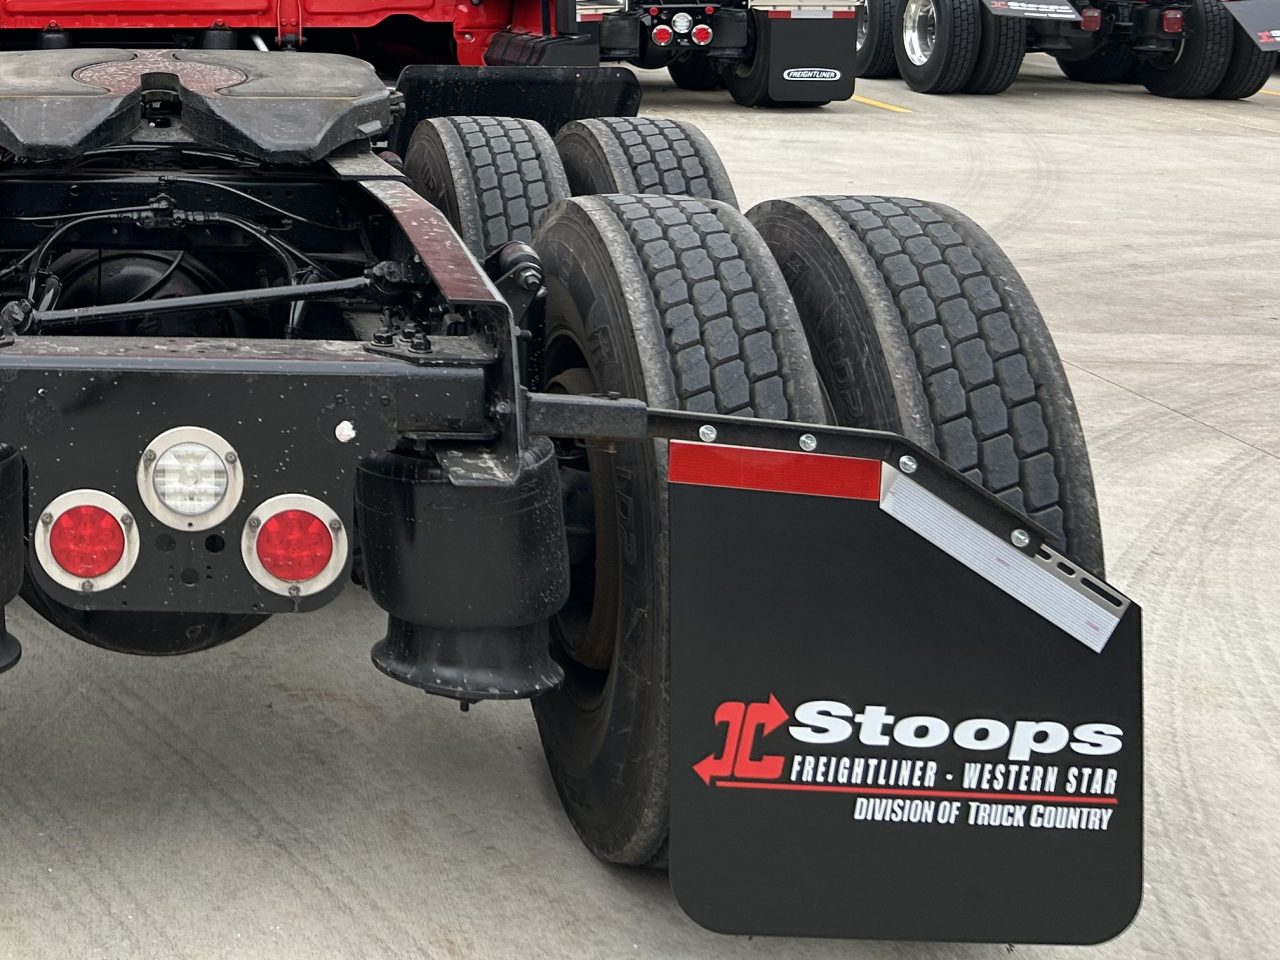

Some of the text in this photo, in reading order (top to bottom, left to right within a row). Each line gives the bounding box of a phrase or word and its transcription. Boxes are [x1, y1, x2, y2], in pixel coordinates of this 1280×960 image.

[788, 700, 1124, 762] Stoops
[790, 755, 938, 788] FREIGHTLINER
[963, 763, 1059, 793] WESTERN
[1066, 767, 1118, 795] STAR
[853, 798, 1114, 831] DIVISION OF TRUCK COUNTRY
